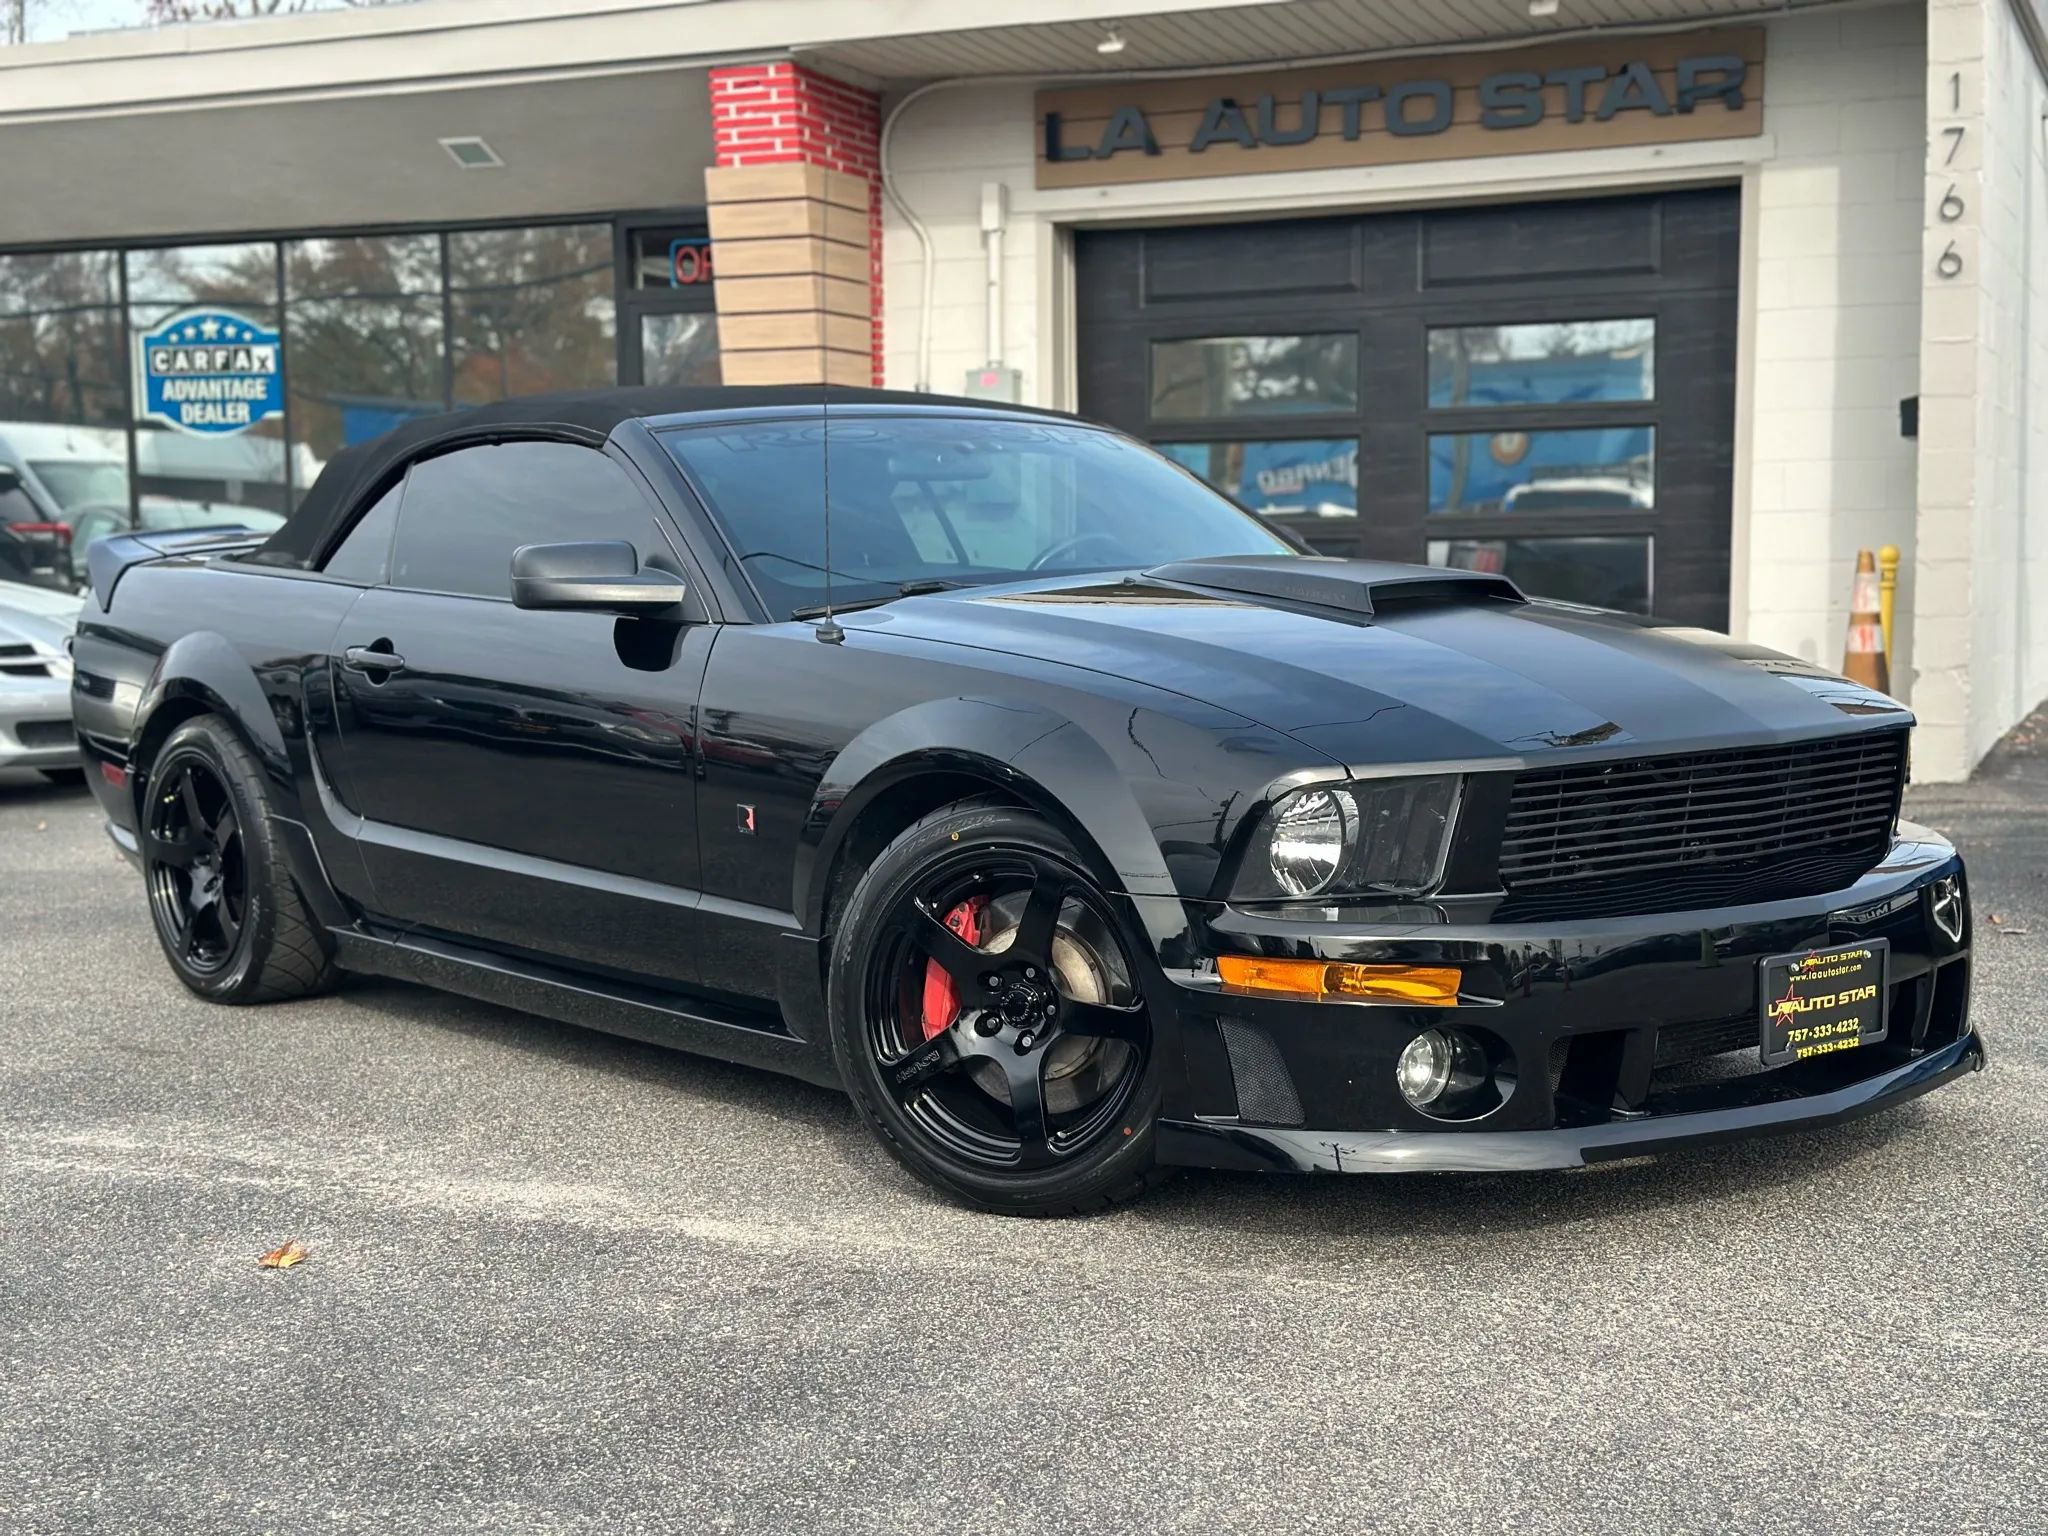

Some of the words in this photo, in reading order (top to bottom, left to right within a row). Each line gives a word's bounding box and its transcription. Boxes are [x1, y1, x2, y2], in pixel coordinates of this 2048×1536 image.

[1045, 105, 1161, 163] LA
[1189, 79, 1454, 152] AUTO
[1480, 55, 1746, 130] STAR
[1936, 71, 1966, 279] 1766
[153, 348, 274, 372] CARFAX
[162, 377, 268, 401] ADVANTAGE
[180, 401, 251, 425] DEALER
[1840, 949, 1863, 960] STAR
[1789, 964, 1862, 982] www.laautostar.com
[1788, 994, 1836, 1013] AUTO
[1838, 984, 1877, 1005] STAR
